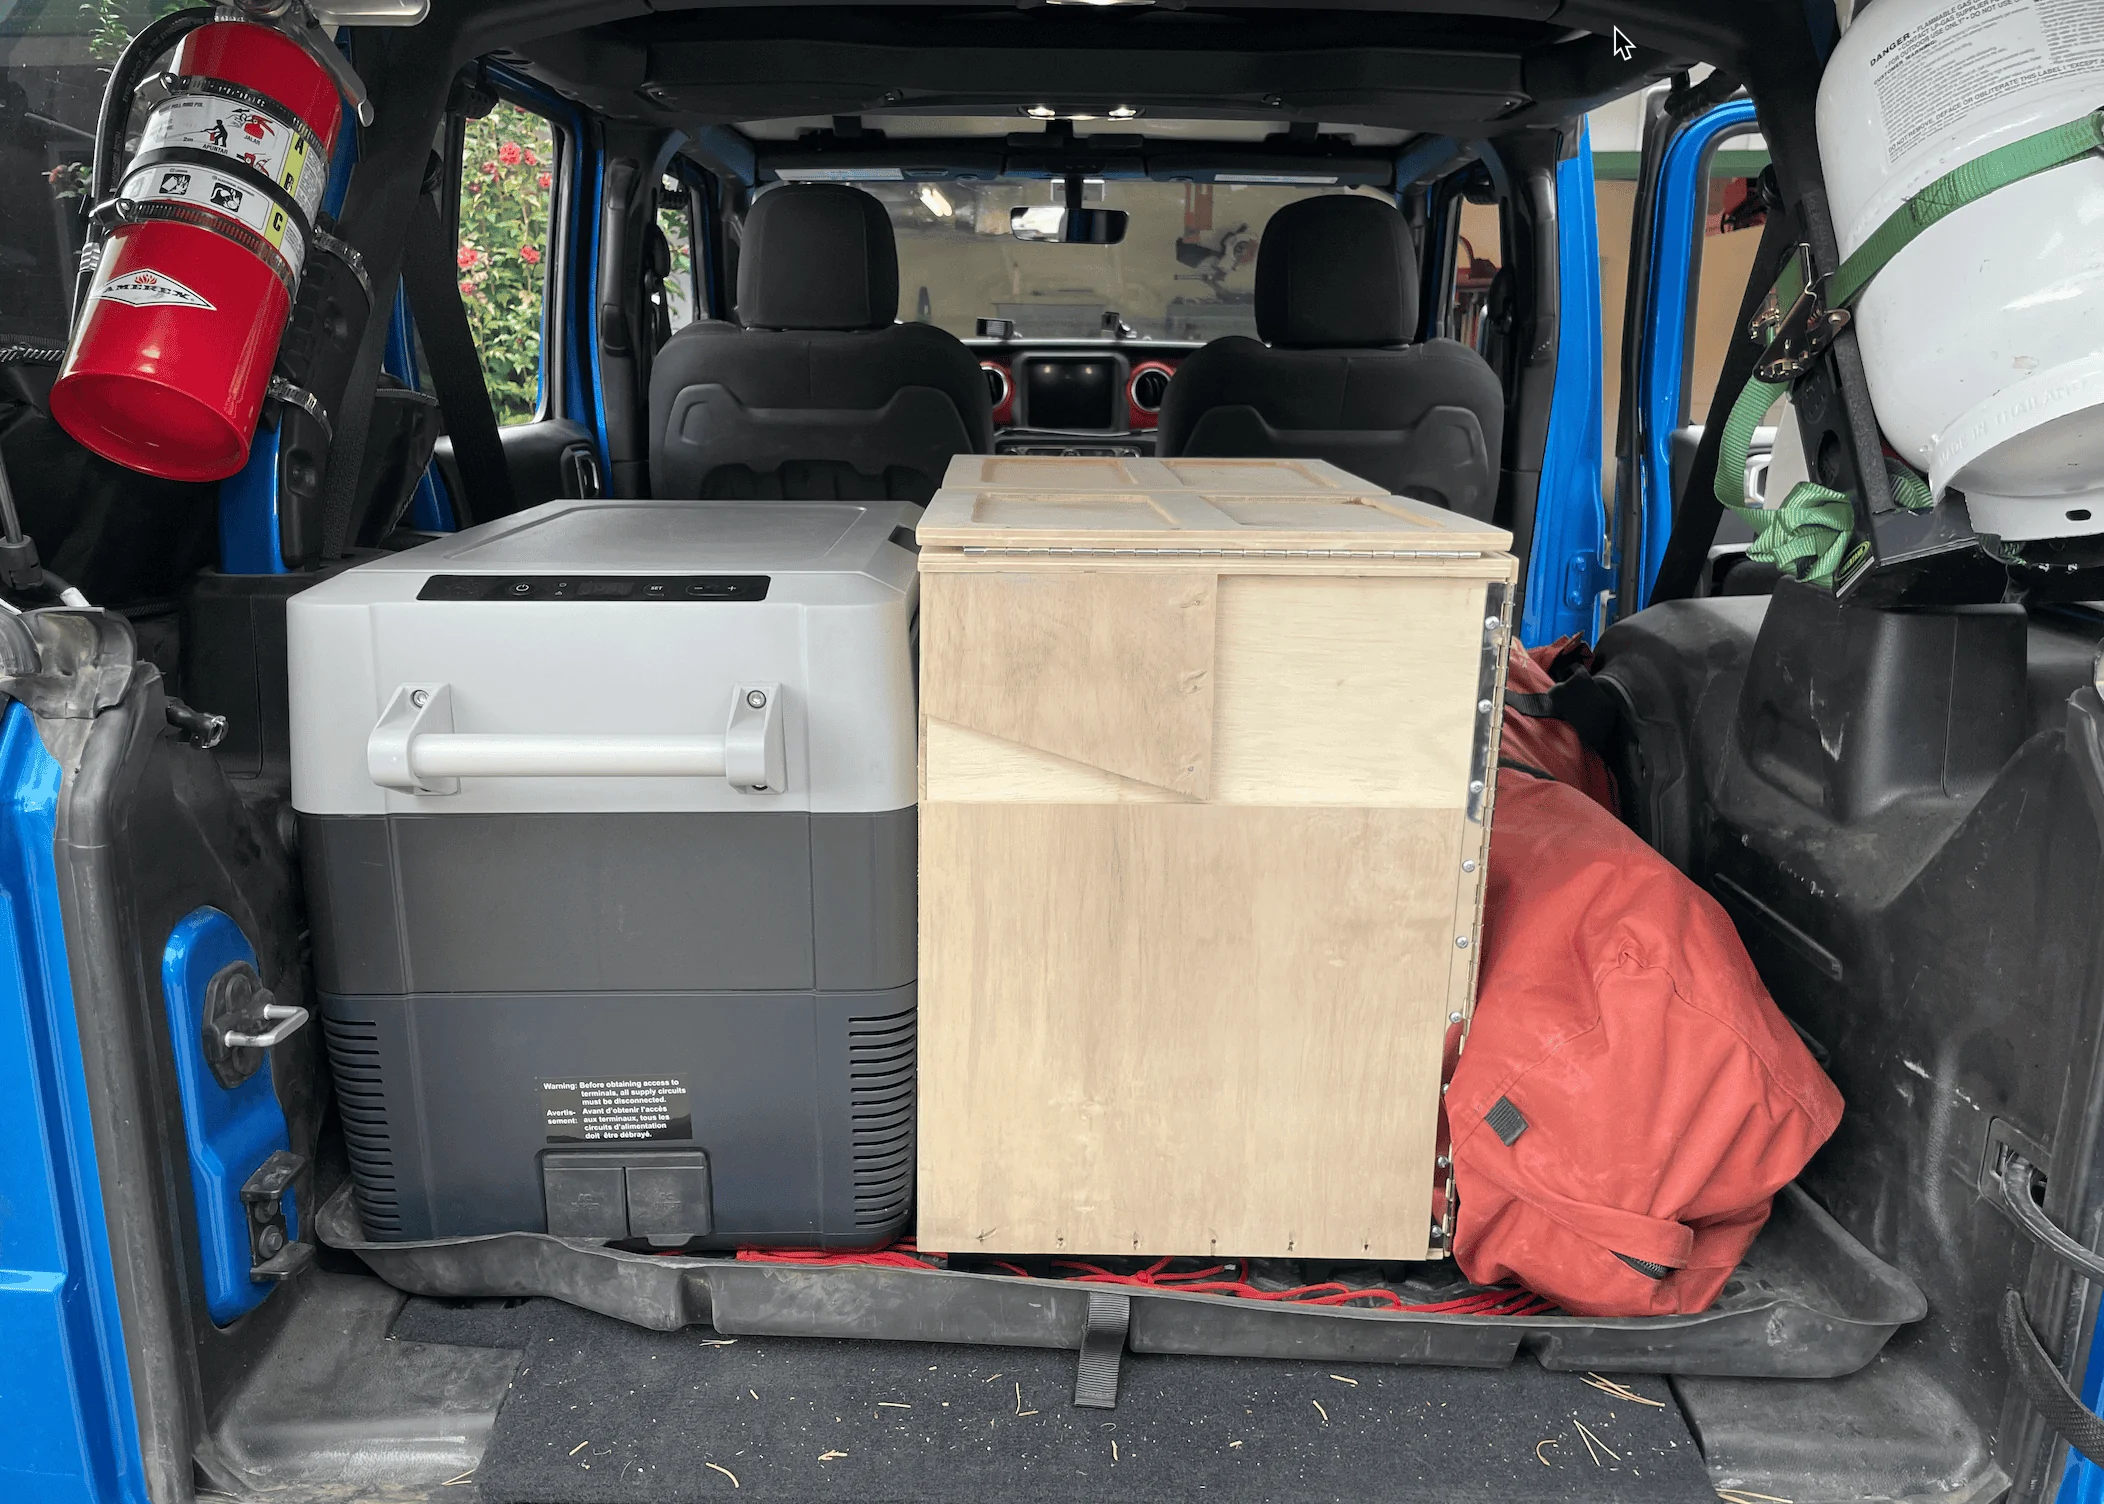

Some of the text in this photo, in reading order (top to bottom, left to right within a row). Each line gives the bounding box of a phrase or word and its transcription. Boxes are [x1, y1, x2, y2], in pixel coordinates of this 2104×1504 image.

[1870, 32, 1910, 67] DANGER
[1917, 7, 1956, 31] FLAMMABLE
[1900, 35, 1930, 58] OUTDOOR
[1930, 27, 1944, 39] USE
[1970, 10, 1981, 19] DO
[1981, 3, 1996, 14] NOT
[1901, 28, 1929, 49] CONTACT
[1930, 14, 1955, 31] LP-GAS
[1873, 60, 1903, 85] CUSTOMER
[1888, 144, 1897, 153] DO
[1897, 134, 1908, 146] NOT
[1936, 102, 1962, 120] DEFACE
[1962, 96, 1974, 106] OR
[1974, 78, 2019, 100] OBLITERATE
[2020, 72, 2037, 82] THIS
[2037, 65, 2062, 77] LABEL
[244, 135, 261, 146] JALAR
[294, 137, 304, 155] A
[202, 143, 228, 155] APUNTAR
[283, 173, 294, 191] B
[272, 212, 283, 232] C
[102, 284, 190, 301] AMEREX
[543, 1082, 578, 1091] Warning:
[579, 1081, 605, 1089] Before
[606, 1080, 642, 1089] obtaining
[581, 1089, 619, 1097] terminals,
[631, 1088, 657, 1096] supply
[657, 1087, 686, 1095] circuits
[582, 1098, 602, 1106] must
[613, 1096, 667, 1105] disconnected.
[546, 1105, 668, 1117] Avertis- Avant d'obtenir l'accès
[547, 1117, 578, 1125] sement:
[598, 1115, 639, 1123] terminaux,
[613, 1122, 667, 1130] d'alimentation
[603, 1131, 619, 1139] être
[619, 1130, 653, 1139] débrayé.
